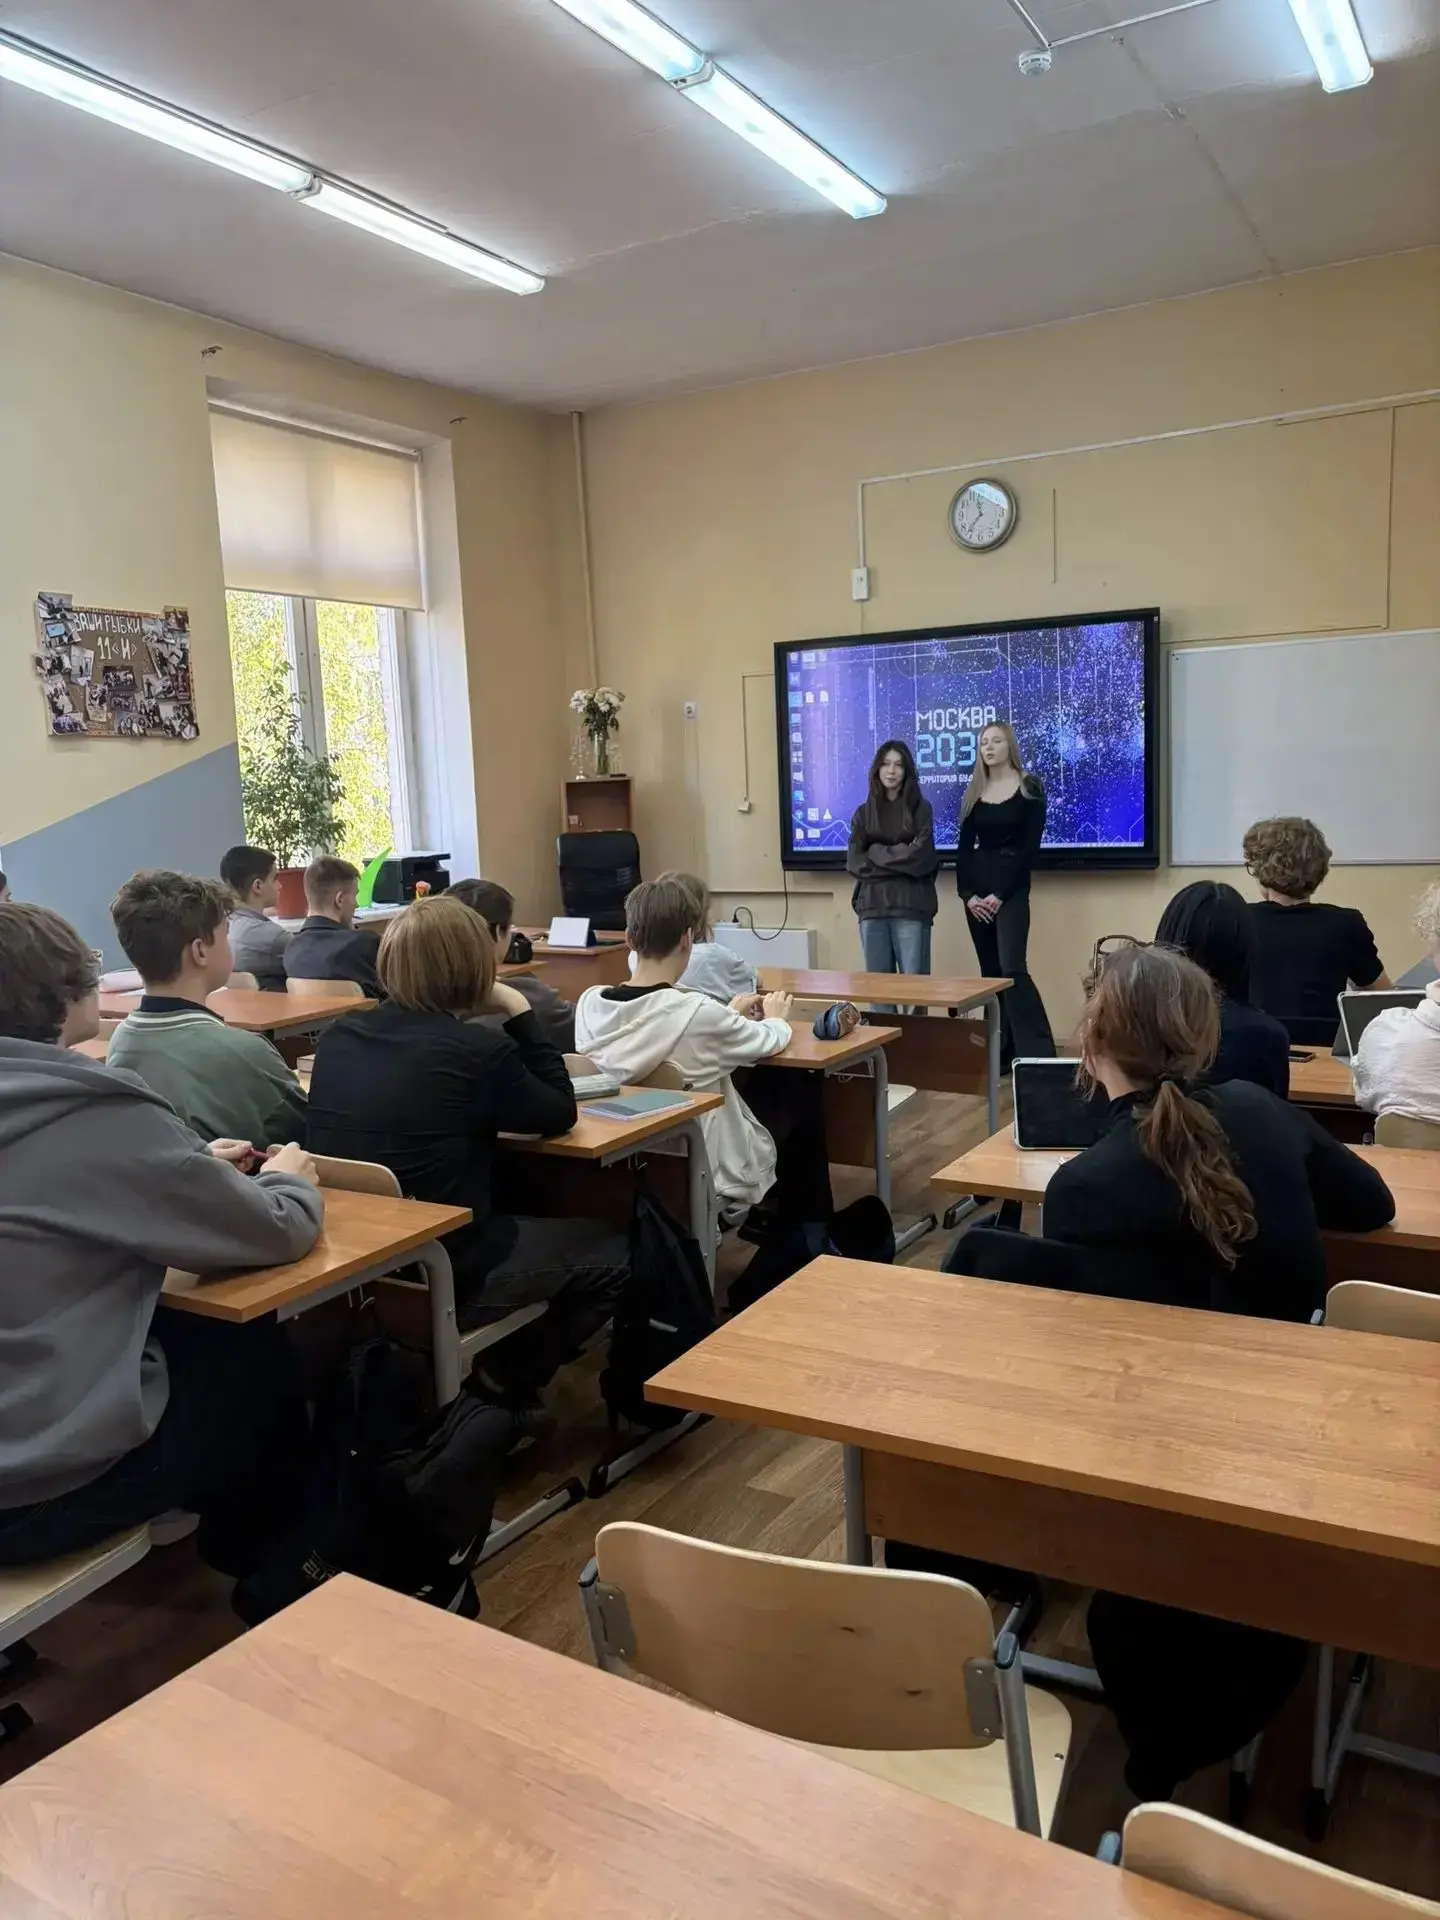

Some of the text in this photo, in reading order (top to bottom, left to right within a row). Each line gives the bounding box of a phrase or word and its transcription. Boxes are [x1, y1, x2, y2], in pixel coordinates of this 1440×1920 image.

[958, 510, 965, 522] 9
[977, 532, 984, 542] 6
[104, 614, 141, 634] РЫБКИ
[915, 705, 997, 732] МОСКВА
[916, 731, 977, 768] 203
